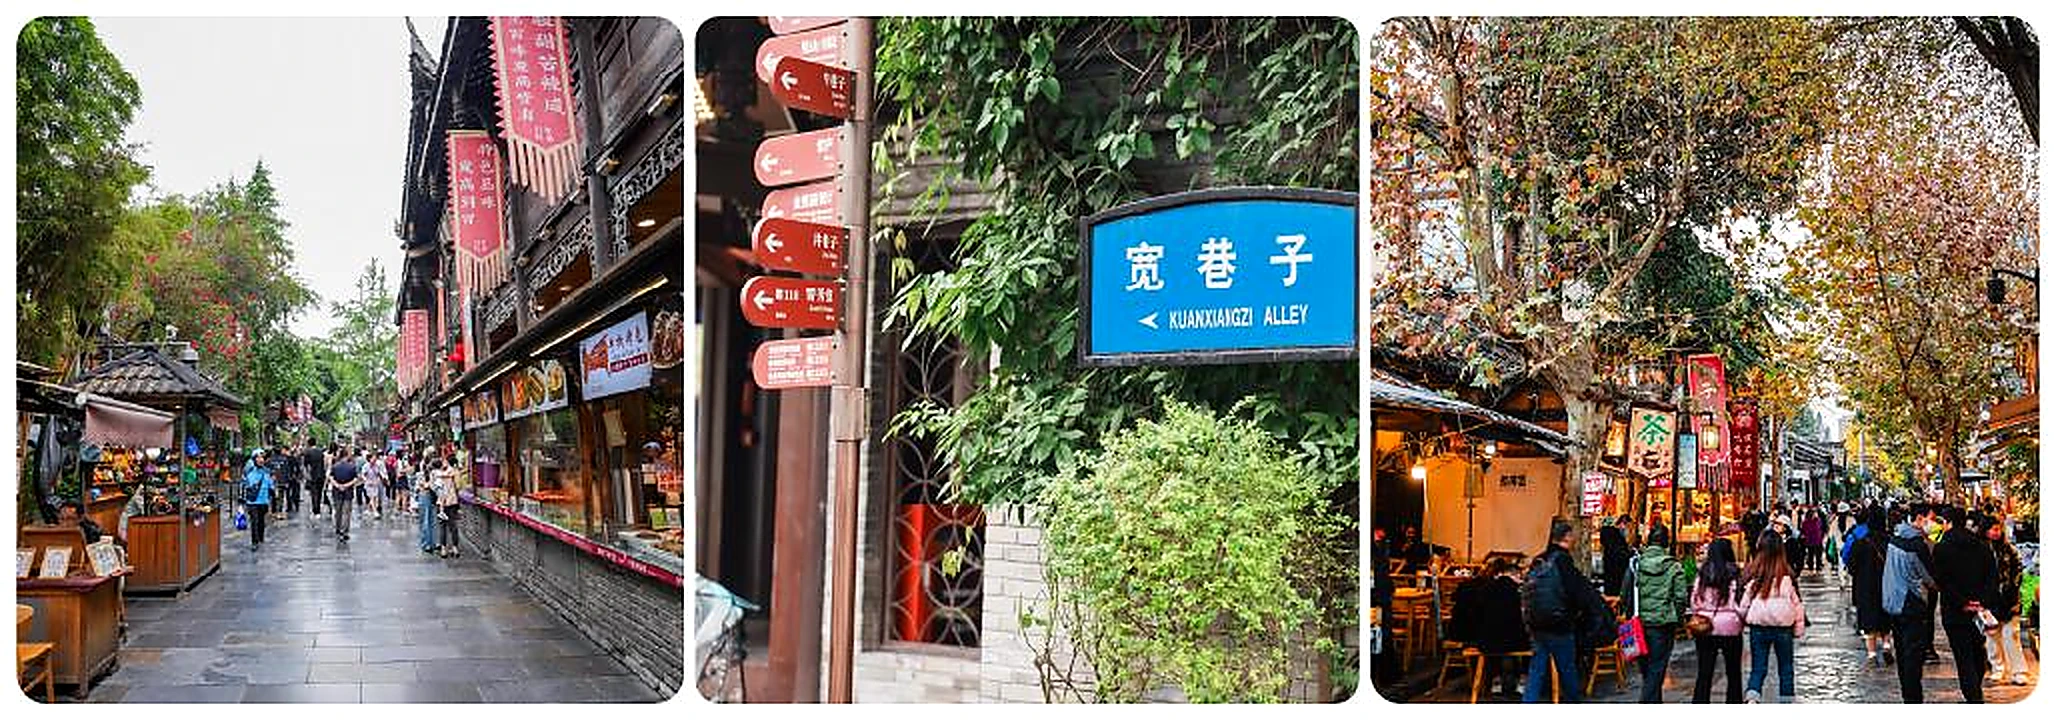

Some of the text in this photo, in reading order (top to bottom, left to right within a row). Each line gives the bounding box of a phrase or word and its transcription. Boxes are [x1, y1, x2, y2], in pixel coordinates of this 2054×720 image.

[1125, 234, 1313, 292] 宽巷子
[1168, 303, 1310, 330] KUANXIANGZI ALLEY
[1636, 413, 1671, 446] 茶
